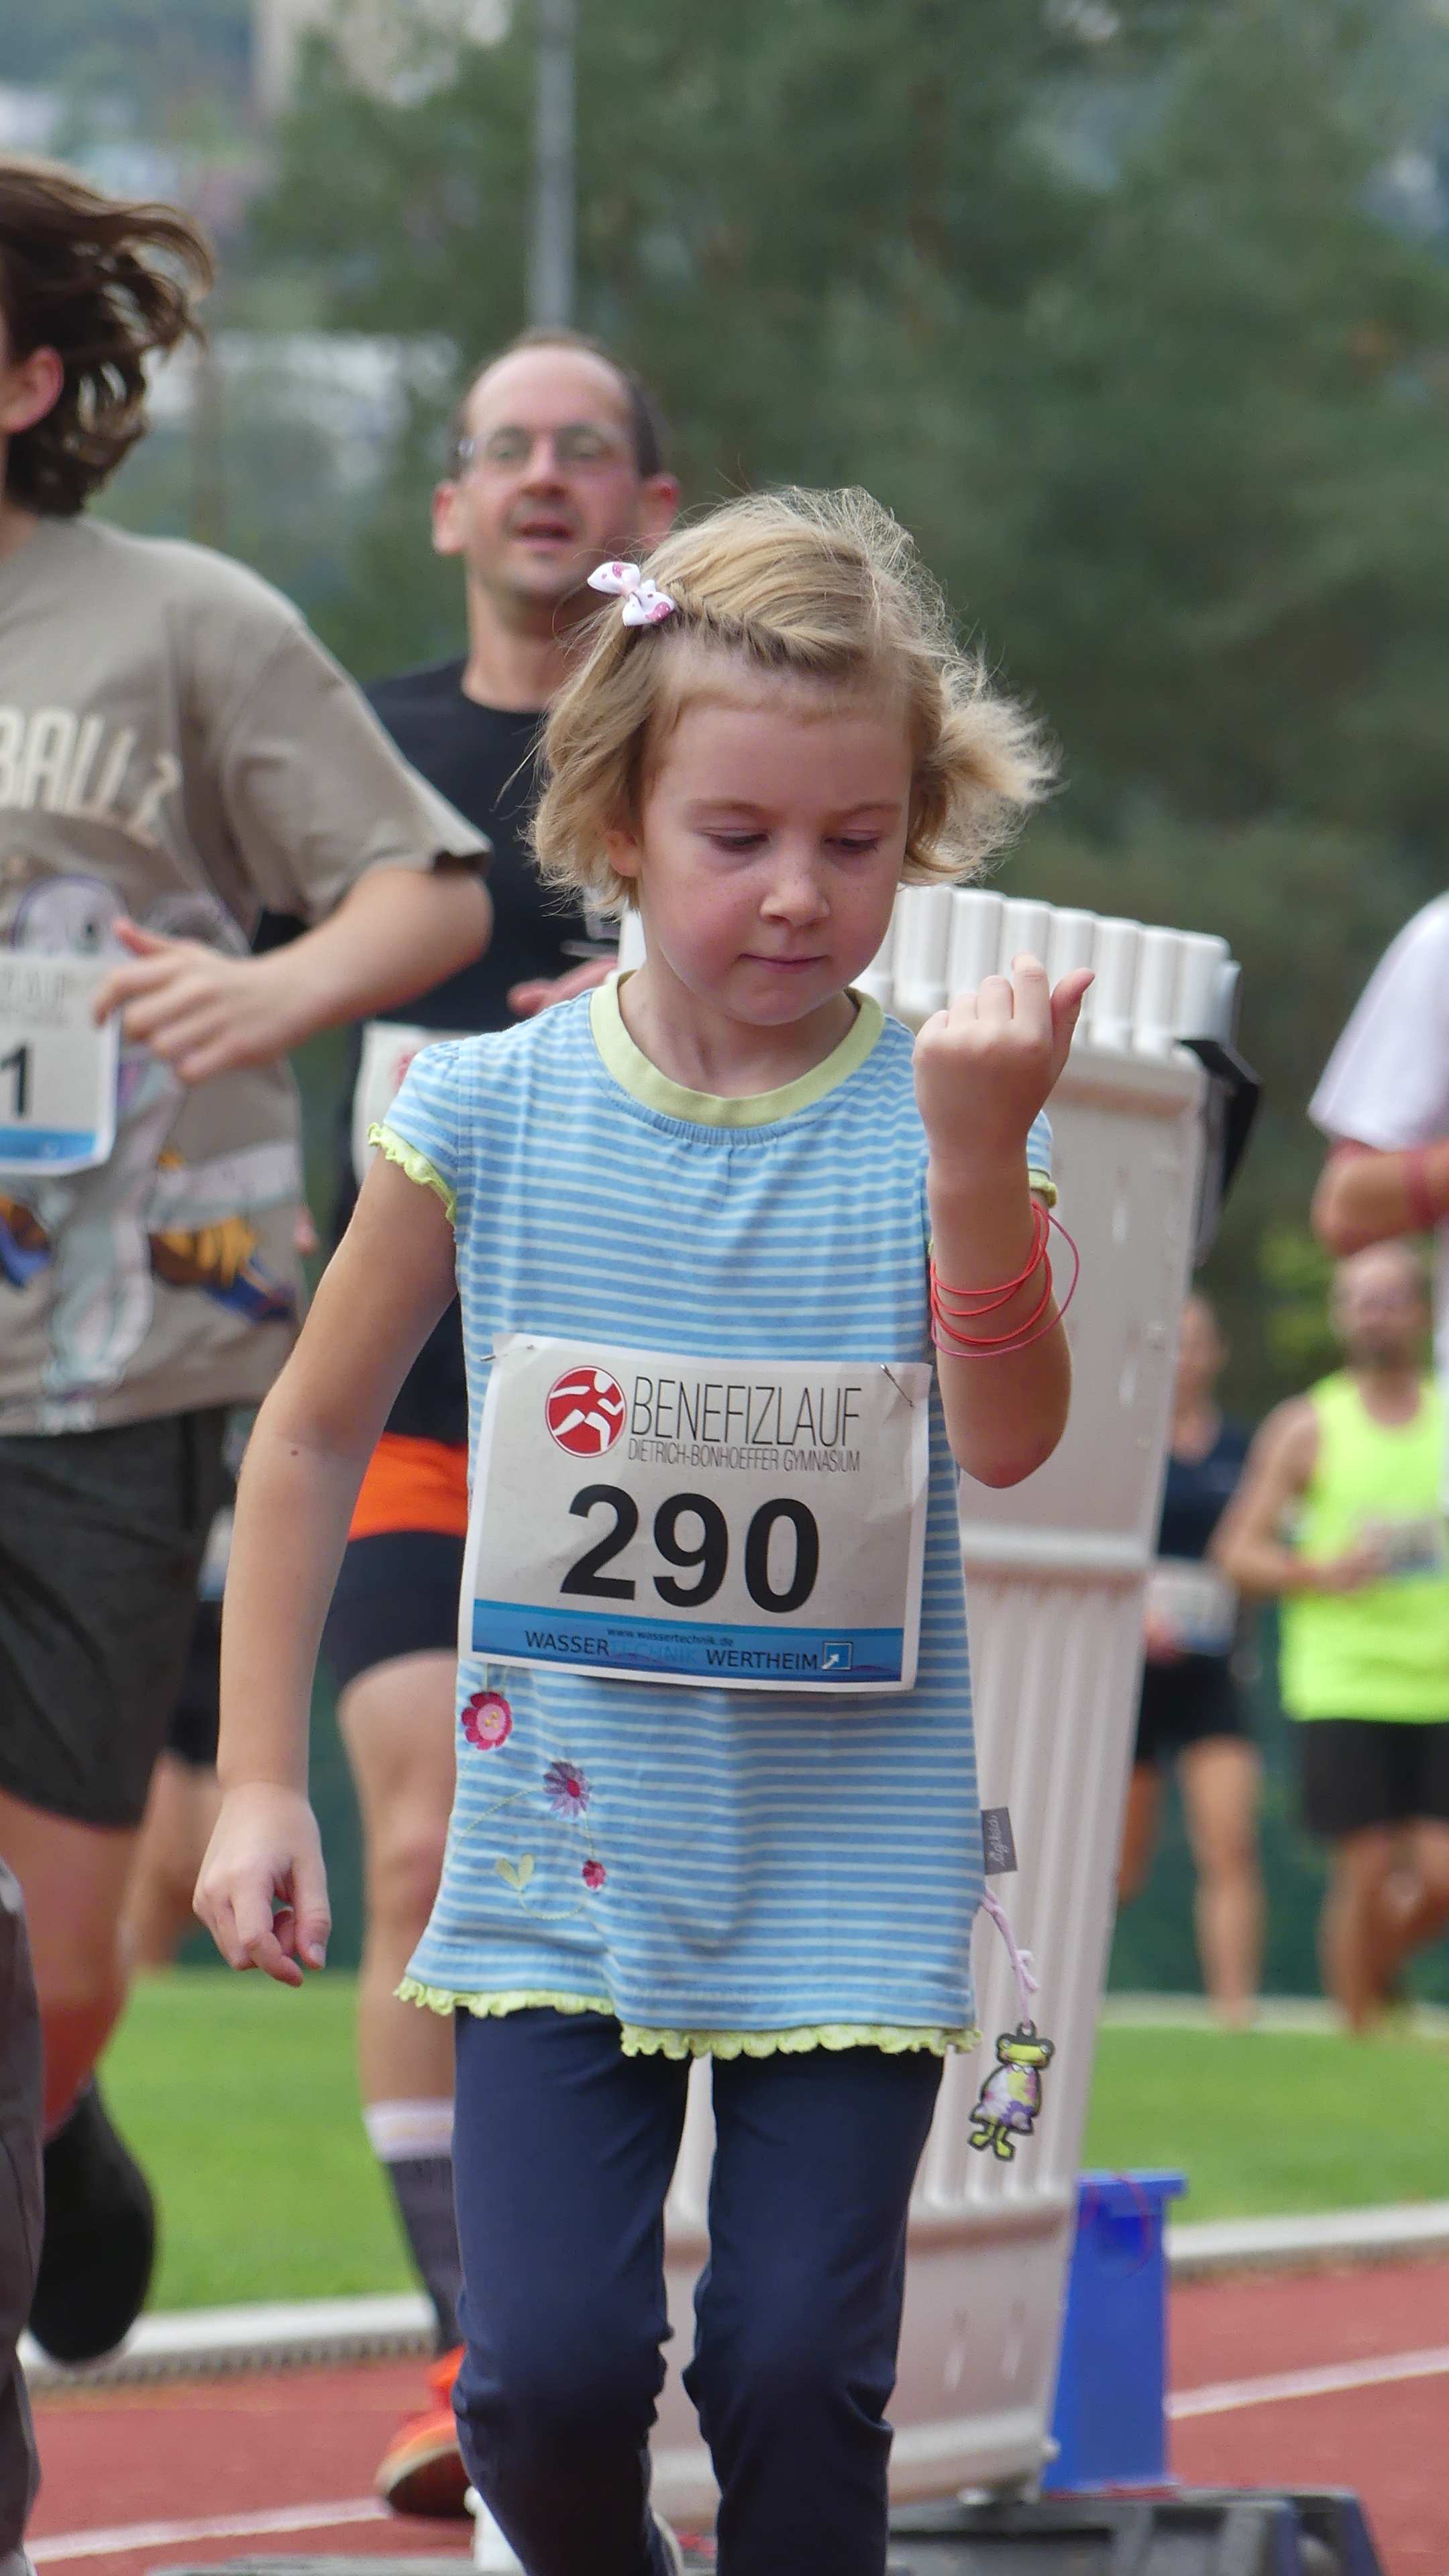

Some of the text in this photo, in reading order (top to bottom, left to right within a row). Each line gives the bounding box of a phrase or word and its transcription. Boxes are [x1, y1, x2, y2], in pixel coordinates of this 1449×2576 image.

[0, 1042, 30, 1118] 1
[631, 1375, 862, 1446] BENEFIZLAUF
[628, 1438, 861, 1473] DIETRICH-BONHOEFFER GYMNASIUM
[559, 1483, 820, 1613] 290
[606, 1628, 734, 1648] www.wassertechnik.de
[706, 1649, 818, 1670] WERTHEIM
